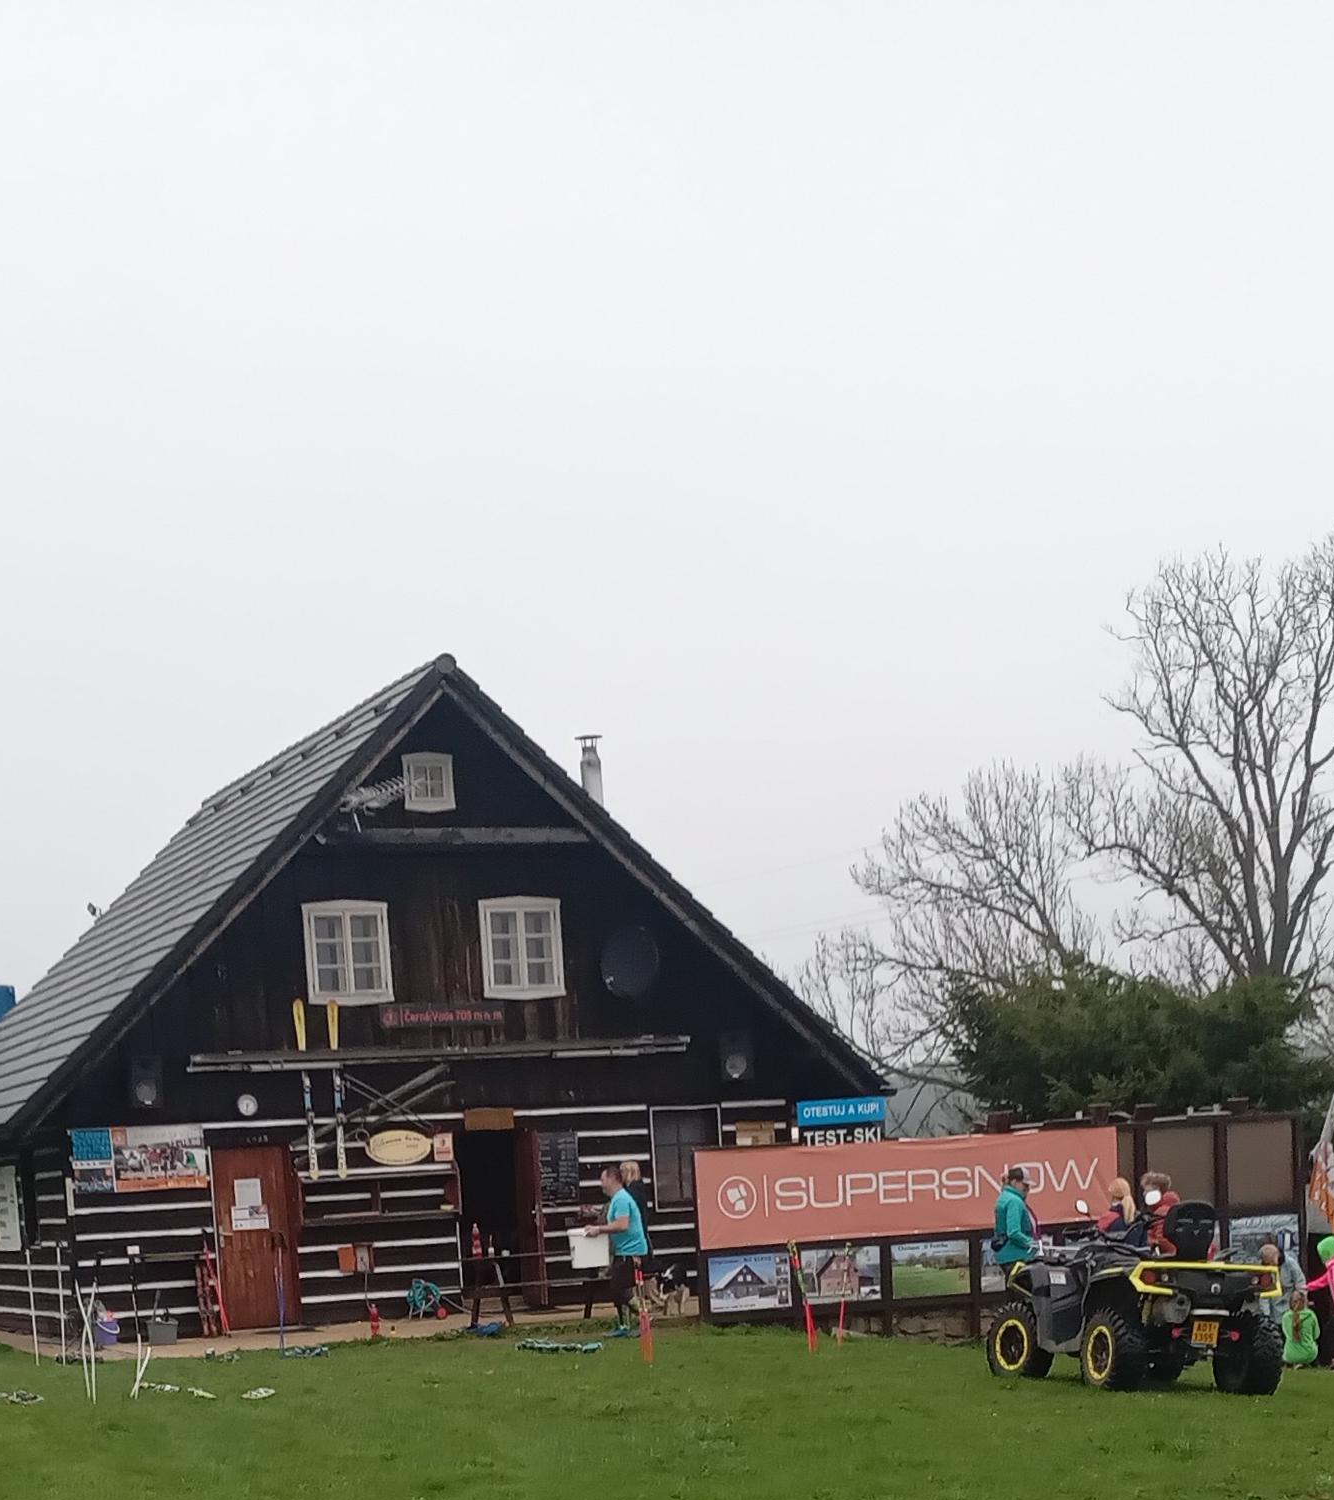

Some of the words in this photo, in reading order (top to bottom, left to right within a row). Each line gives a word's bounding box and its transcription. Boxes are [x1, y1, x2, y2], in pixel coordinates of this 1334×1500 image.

[803, 1105, 845, 1118] OTESTUJ
[848, 1104, 855, 1115] A
[803, 1127, 882, 1147] TEST-SKI
